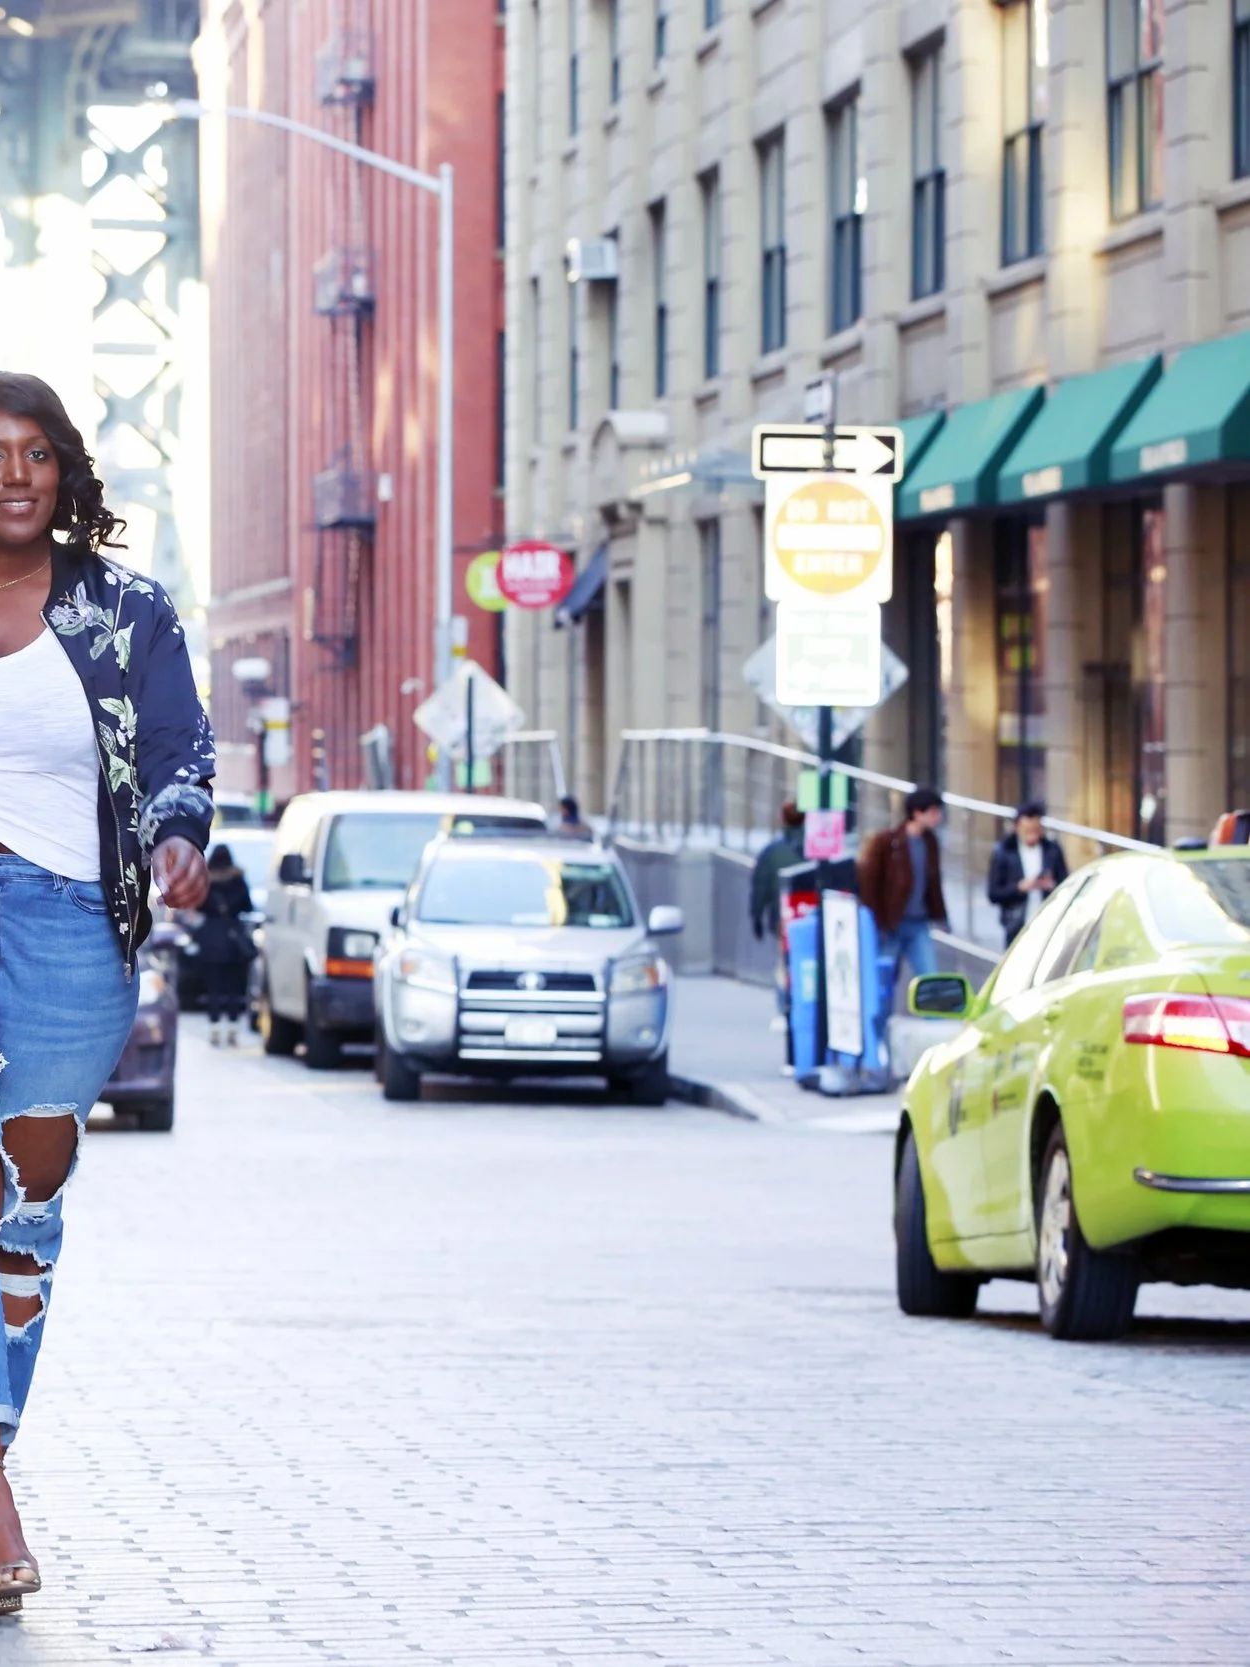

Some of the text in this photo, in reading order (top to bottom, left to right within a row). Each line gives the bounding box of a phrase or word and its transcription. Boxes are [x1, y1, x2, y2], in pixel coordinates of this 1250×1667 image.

[786, 498, 870, 522] DO NOT
[793, 552, 863, 577] ENTER
